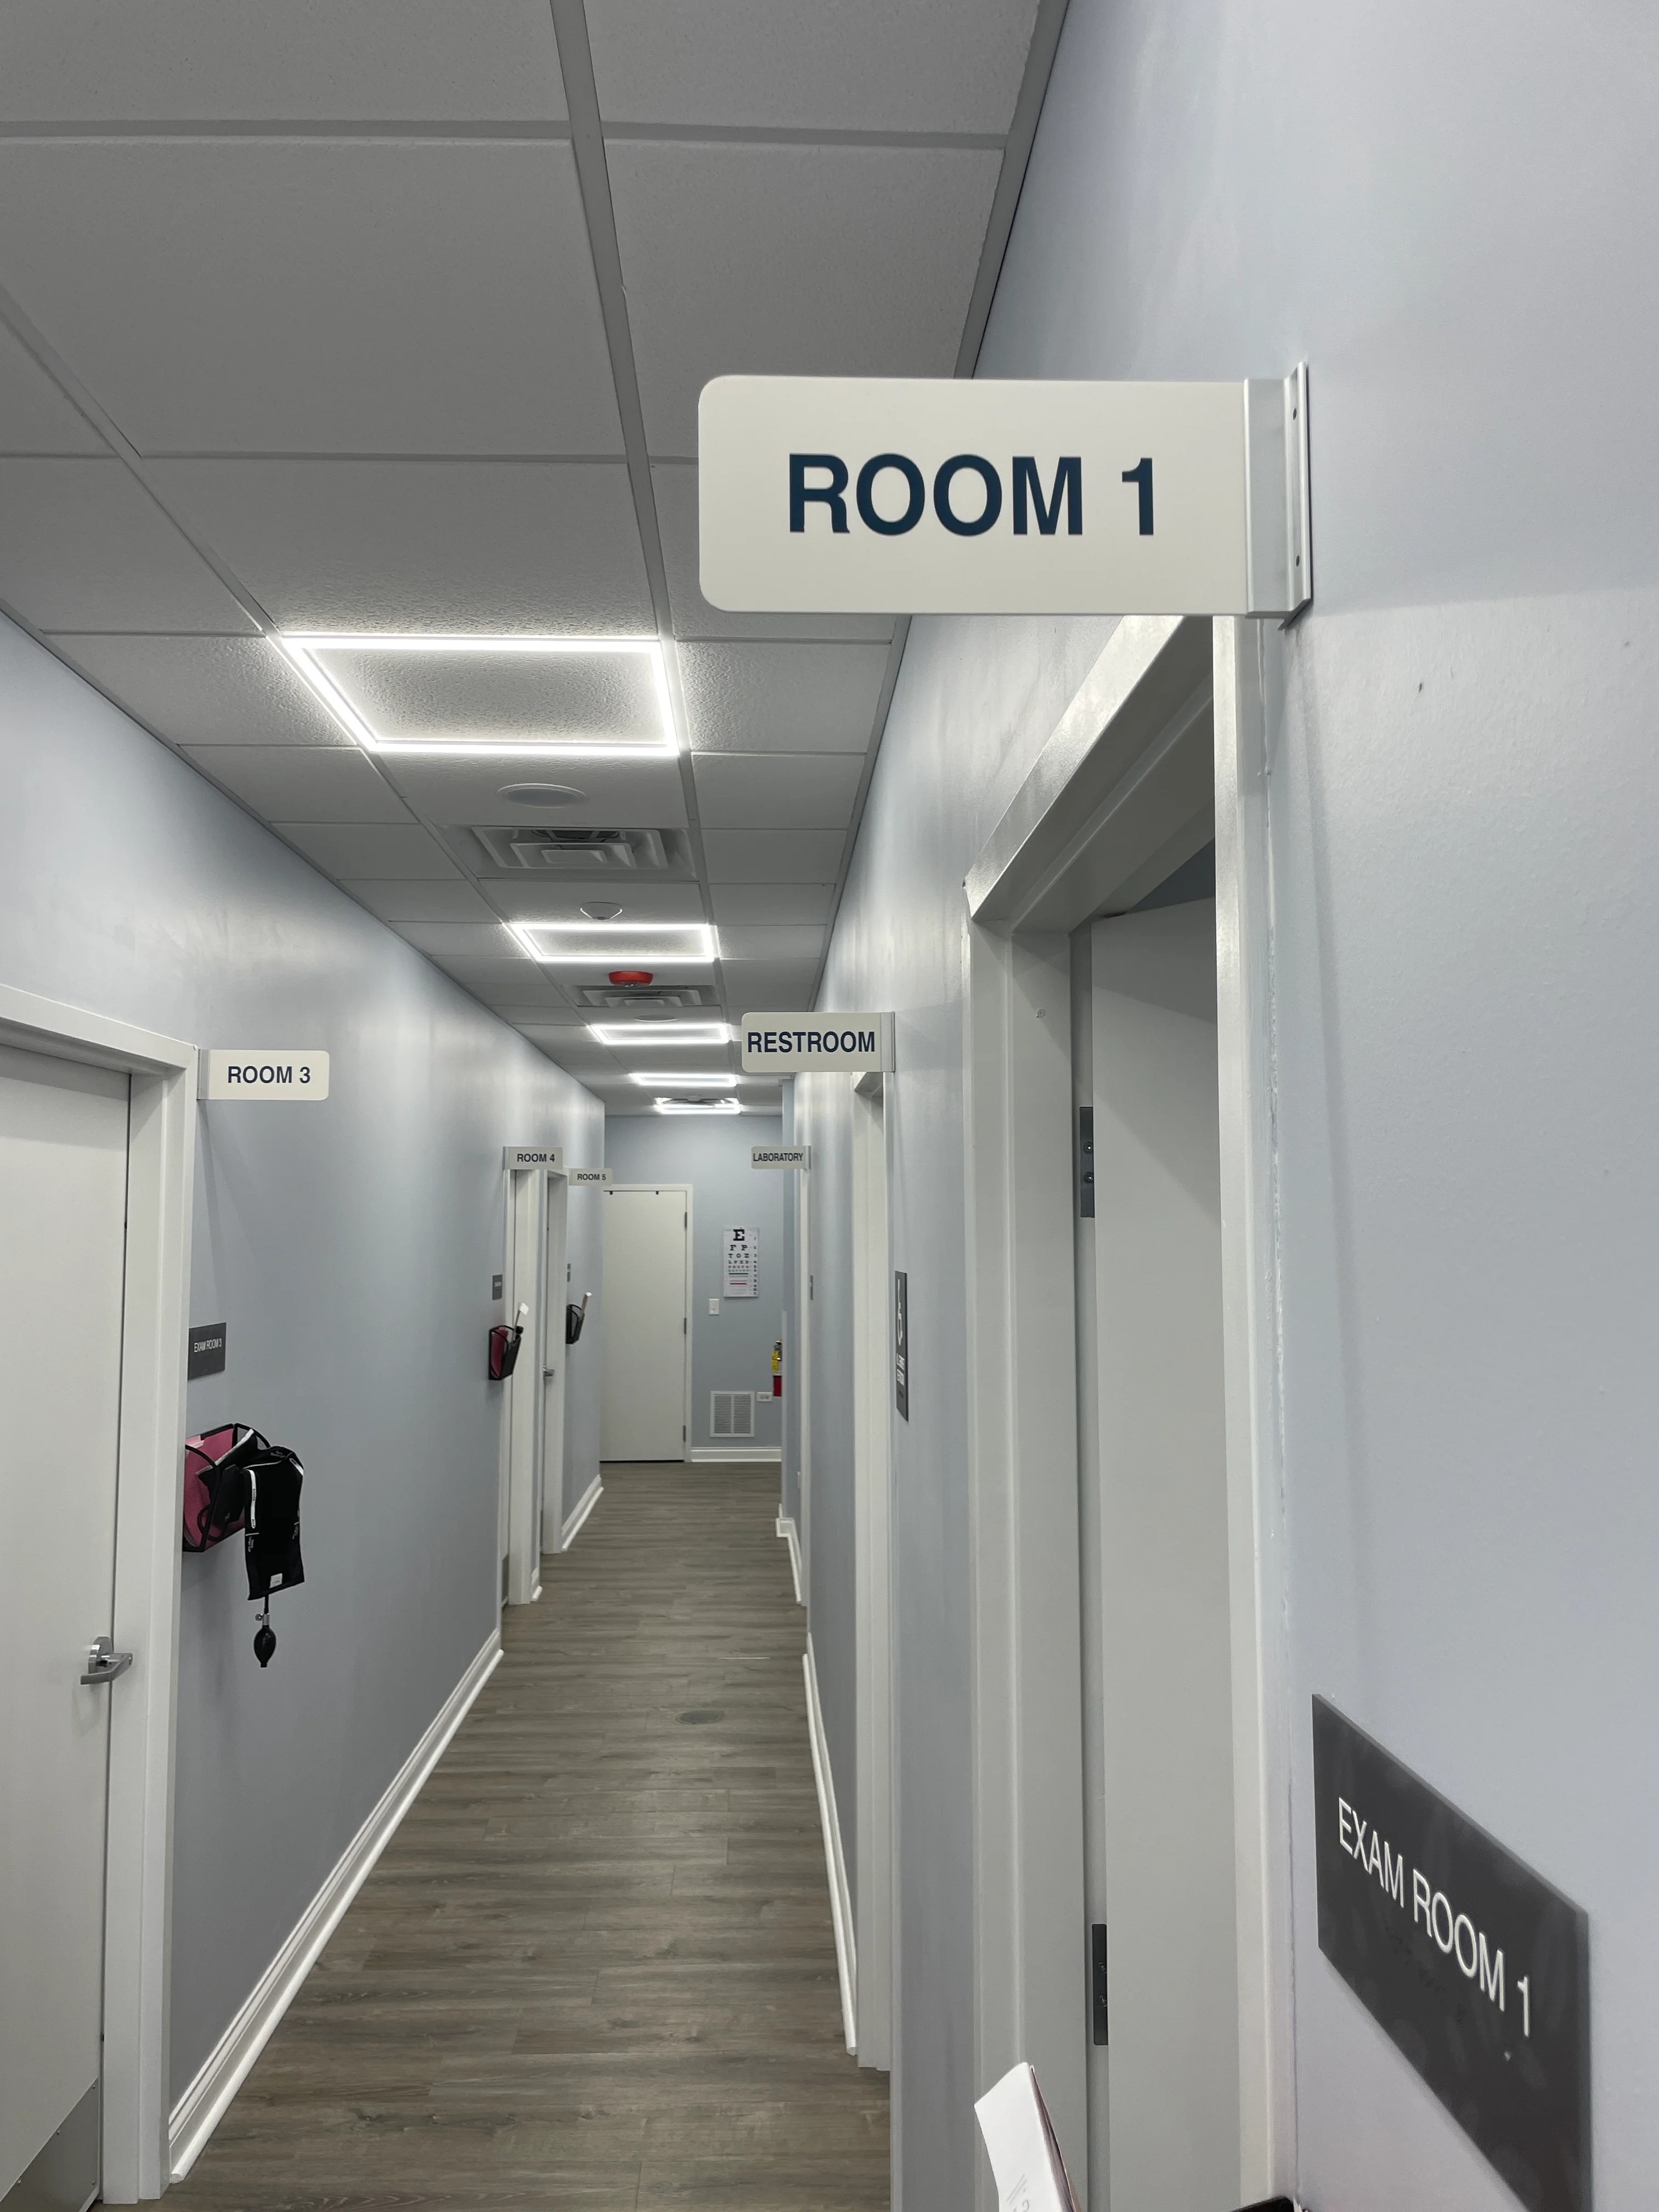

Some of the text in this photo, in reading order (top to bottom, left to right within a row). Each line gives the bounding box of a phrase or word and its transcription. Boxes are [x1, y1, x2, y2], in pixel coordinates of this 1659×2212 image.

[789, 454, 1154, 537] ROOM 1
[747, 1031, 875, 1053] RESTROOM
[228, 1065, 311, 1084] ROOM 3
[517, 1153, 555, 1163] ROOM 4
[753, 1153, 804, 1162] LABORATORY
[733, 1229, 745, 1241] E
[194, 1341, 206, 1352] EXAM
[206, 1339, 219, 1350] ROOM
[1339, 1797, 1529, 2037] EXAM ROOM 1
